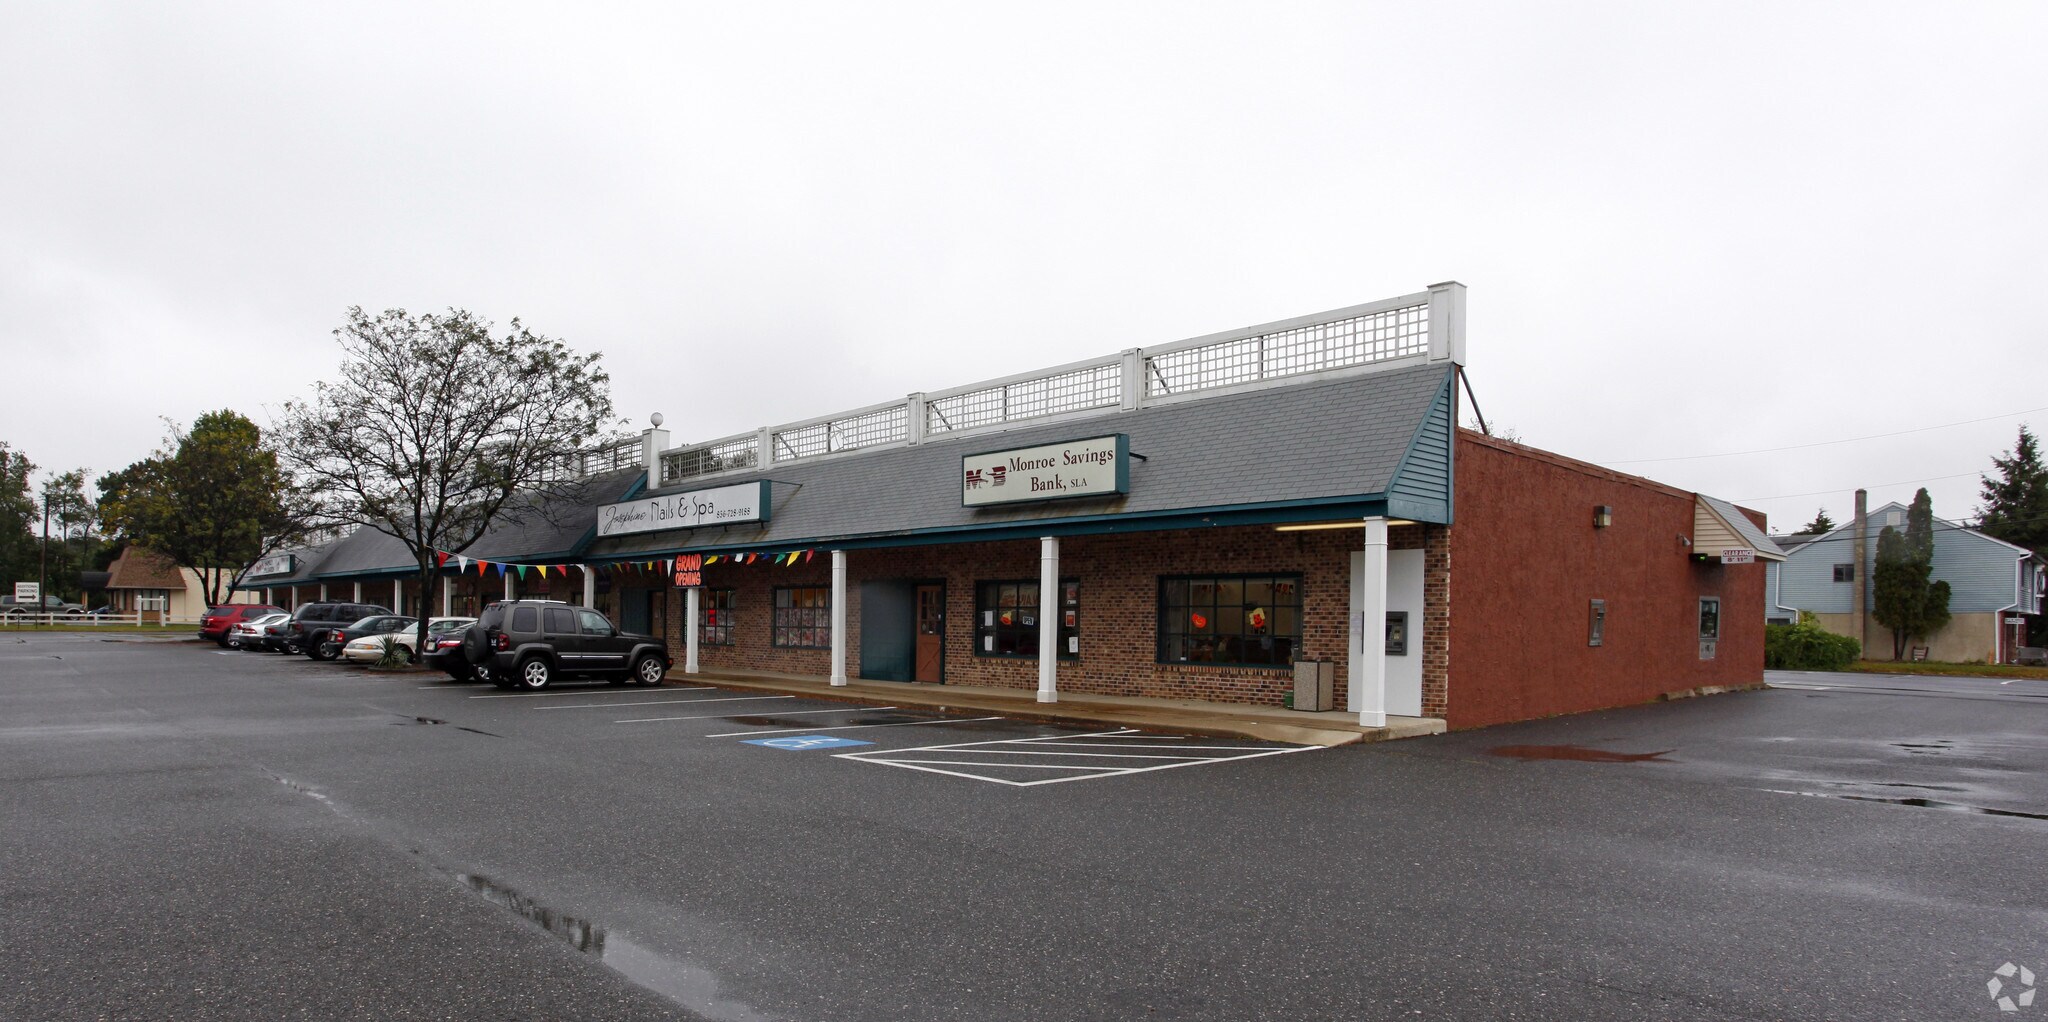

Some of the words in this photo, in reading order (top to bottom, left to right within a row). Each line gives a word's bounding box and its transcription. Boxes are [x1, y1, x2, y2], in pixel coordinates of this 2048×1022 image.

[1009, 457, 1056, 472] Monroe
[1063, 448, 1114, 466] Savings
[1031, 474, 1067, 492] Bank,
[1070, 477, 1088, 488] SLA
[651, 498, 674, 522] Nails
[677, 497, 689, 518] &
[692, 495, 714, 525] Spa
[676, 553, 702, 571] GRAND
[675, 571, 702, 586] OPENING
